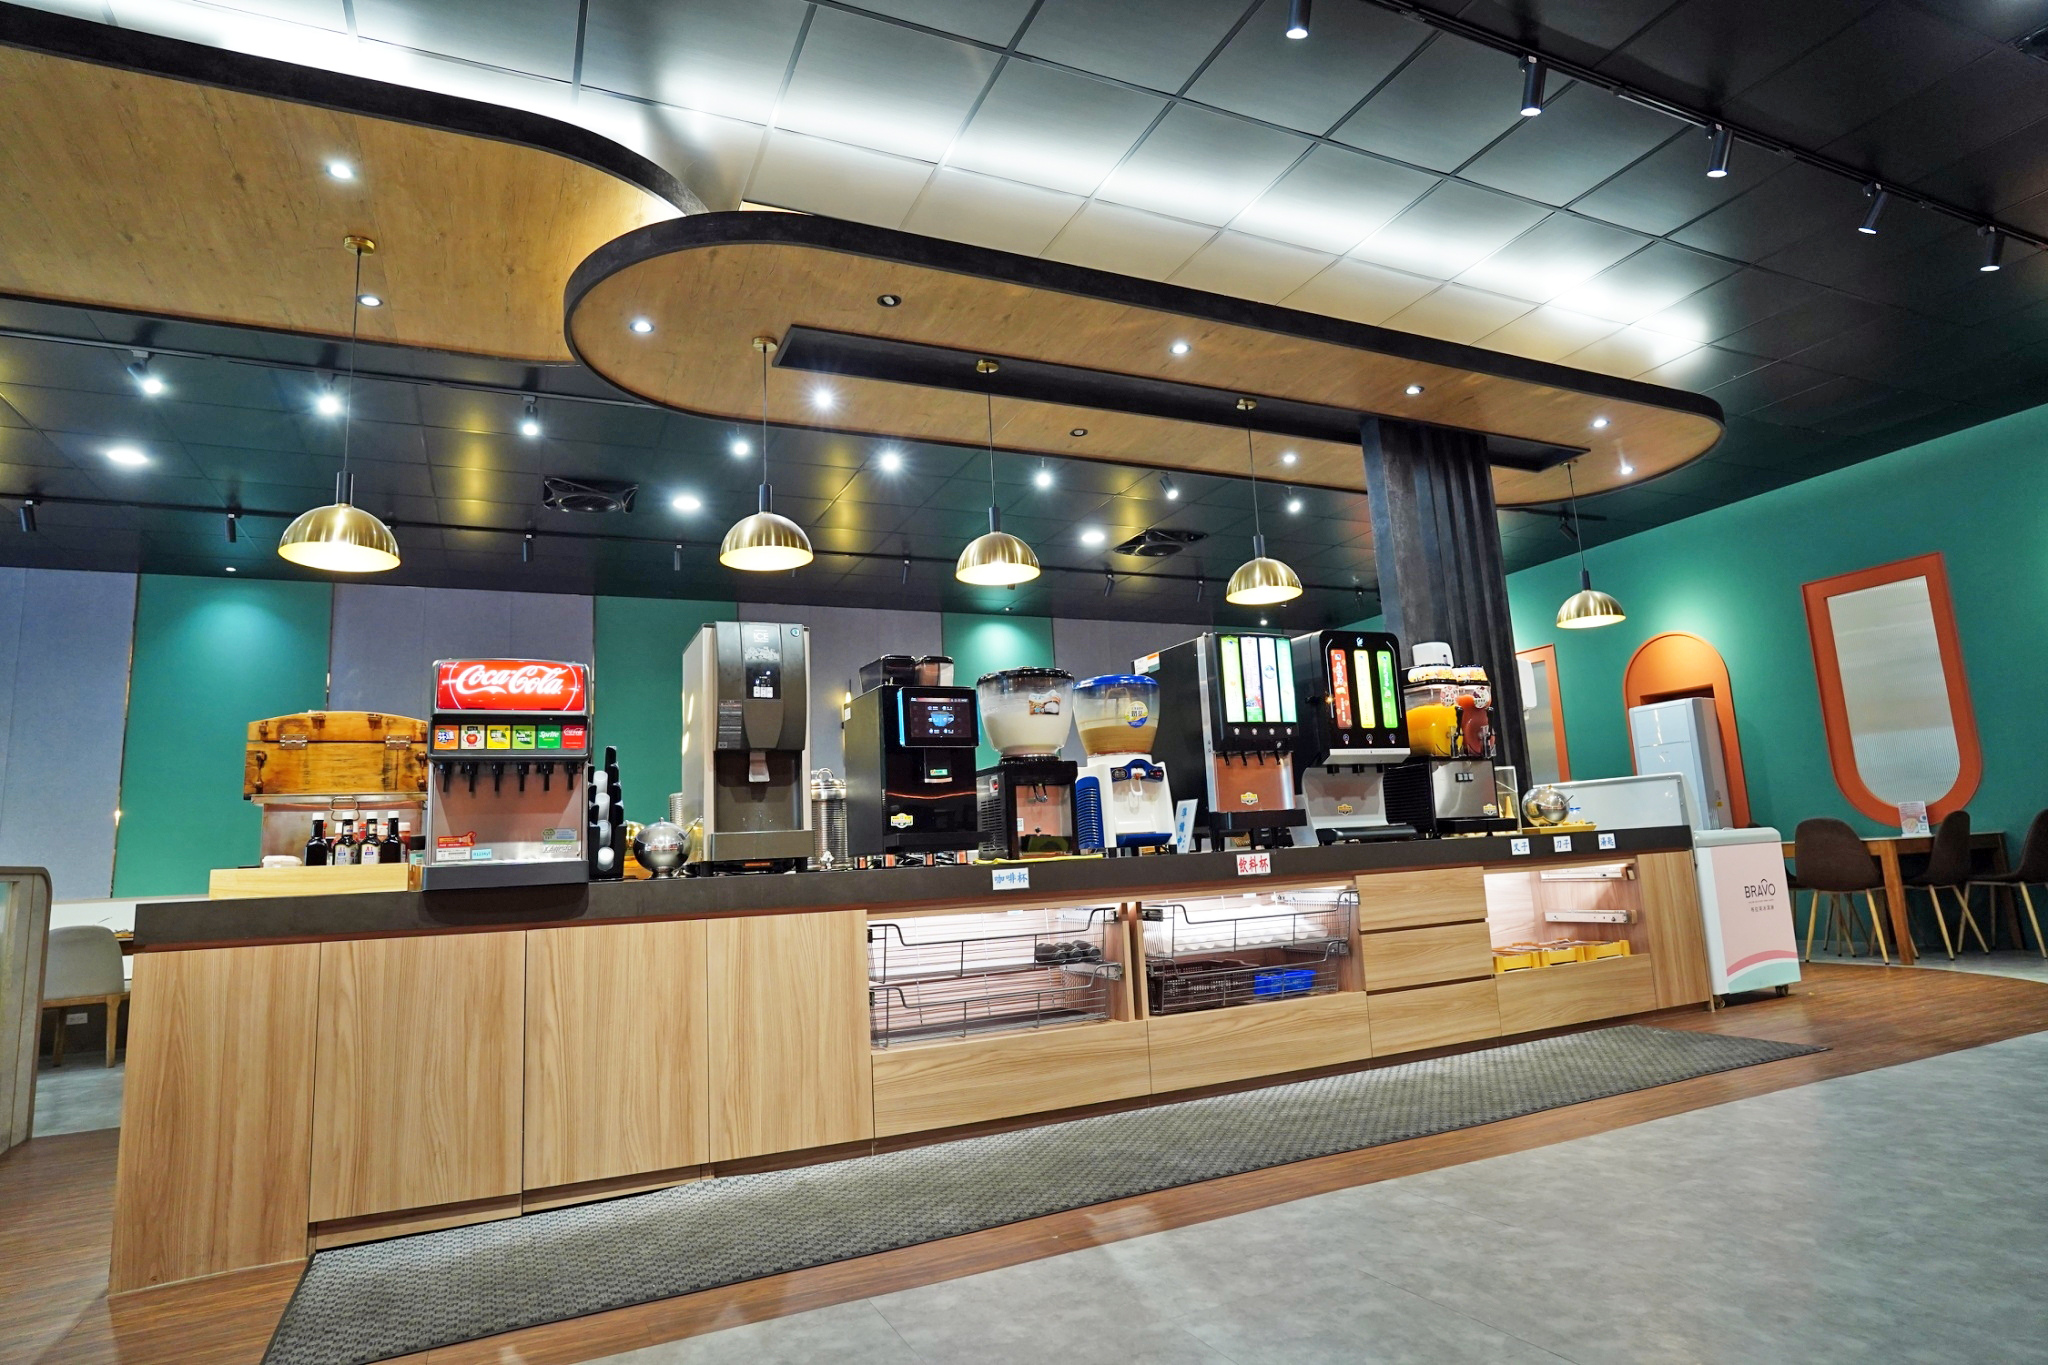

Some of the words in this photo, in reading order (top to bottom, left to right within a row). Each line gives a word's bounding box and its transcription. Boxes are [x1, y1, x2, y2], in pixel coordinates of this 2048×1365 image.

[456, 664, 568, 695] Coca-Cola
[539, 731, 560, 739] Sprite
[1513, 841, 1528, 852] 叉子
[1600, 836, 1615, 847] 湯匙
[1239, 855, 1269, 873] 飲料杯
[994, 872, 1028, 884] 咖啡杯
[1744, 881, 1776, 899] BRAVO
